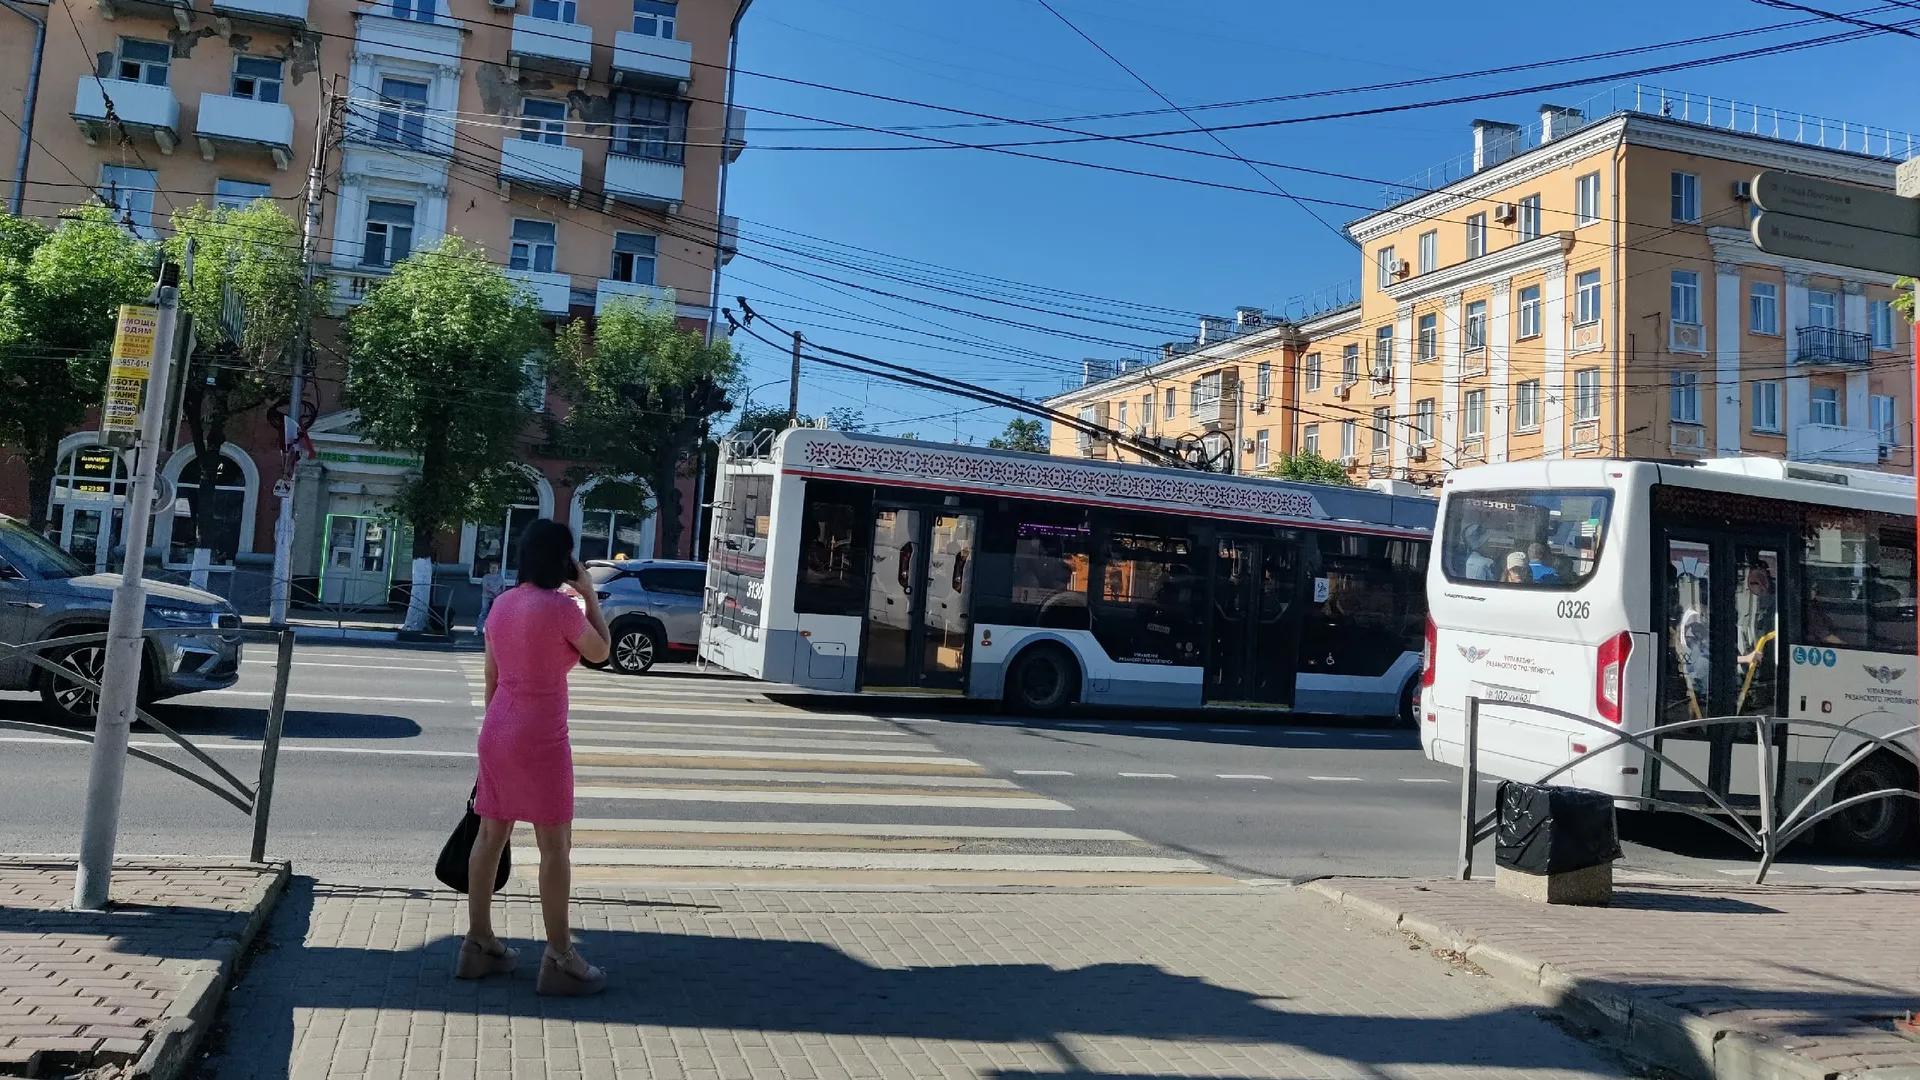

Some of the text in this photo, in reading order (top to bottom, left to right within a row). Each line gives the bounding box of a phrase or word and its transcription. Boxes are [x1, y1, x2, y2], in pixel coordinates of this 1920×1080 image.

[746, 580, 764, 600] 3130
[1557, 600, 1591, 619] 0326
[1866, 688, 1902, 696] УПРАВЛЕНИЕ
